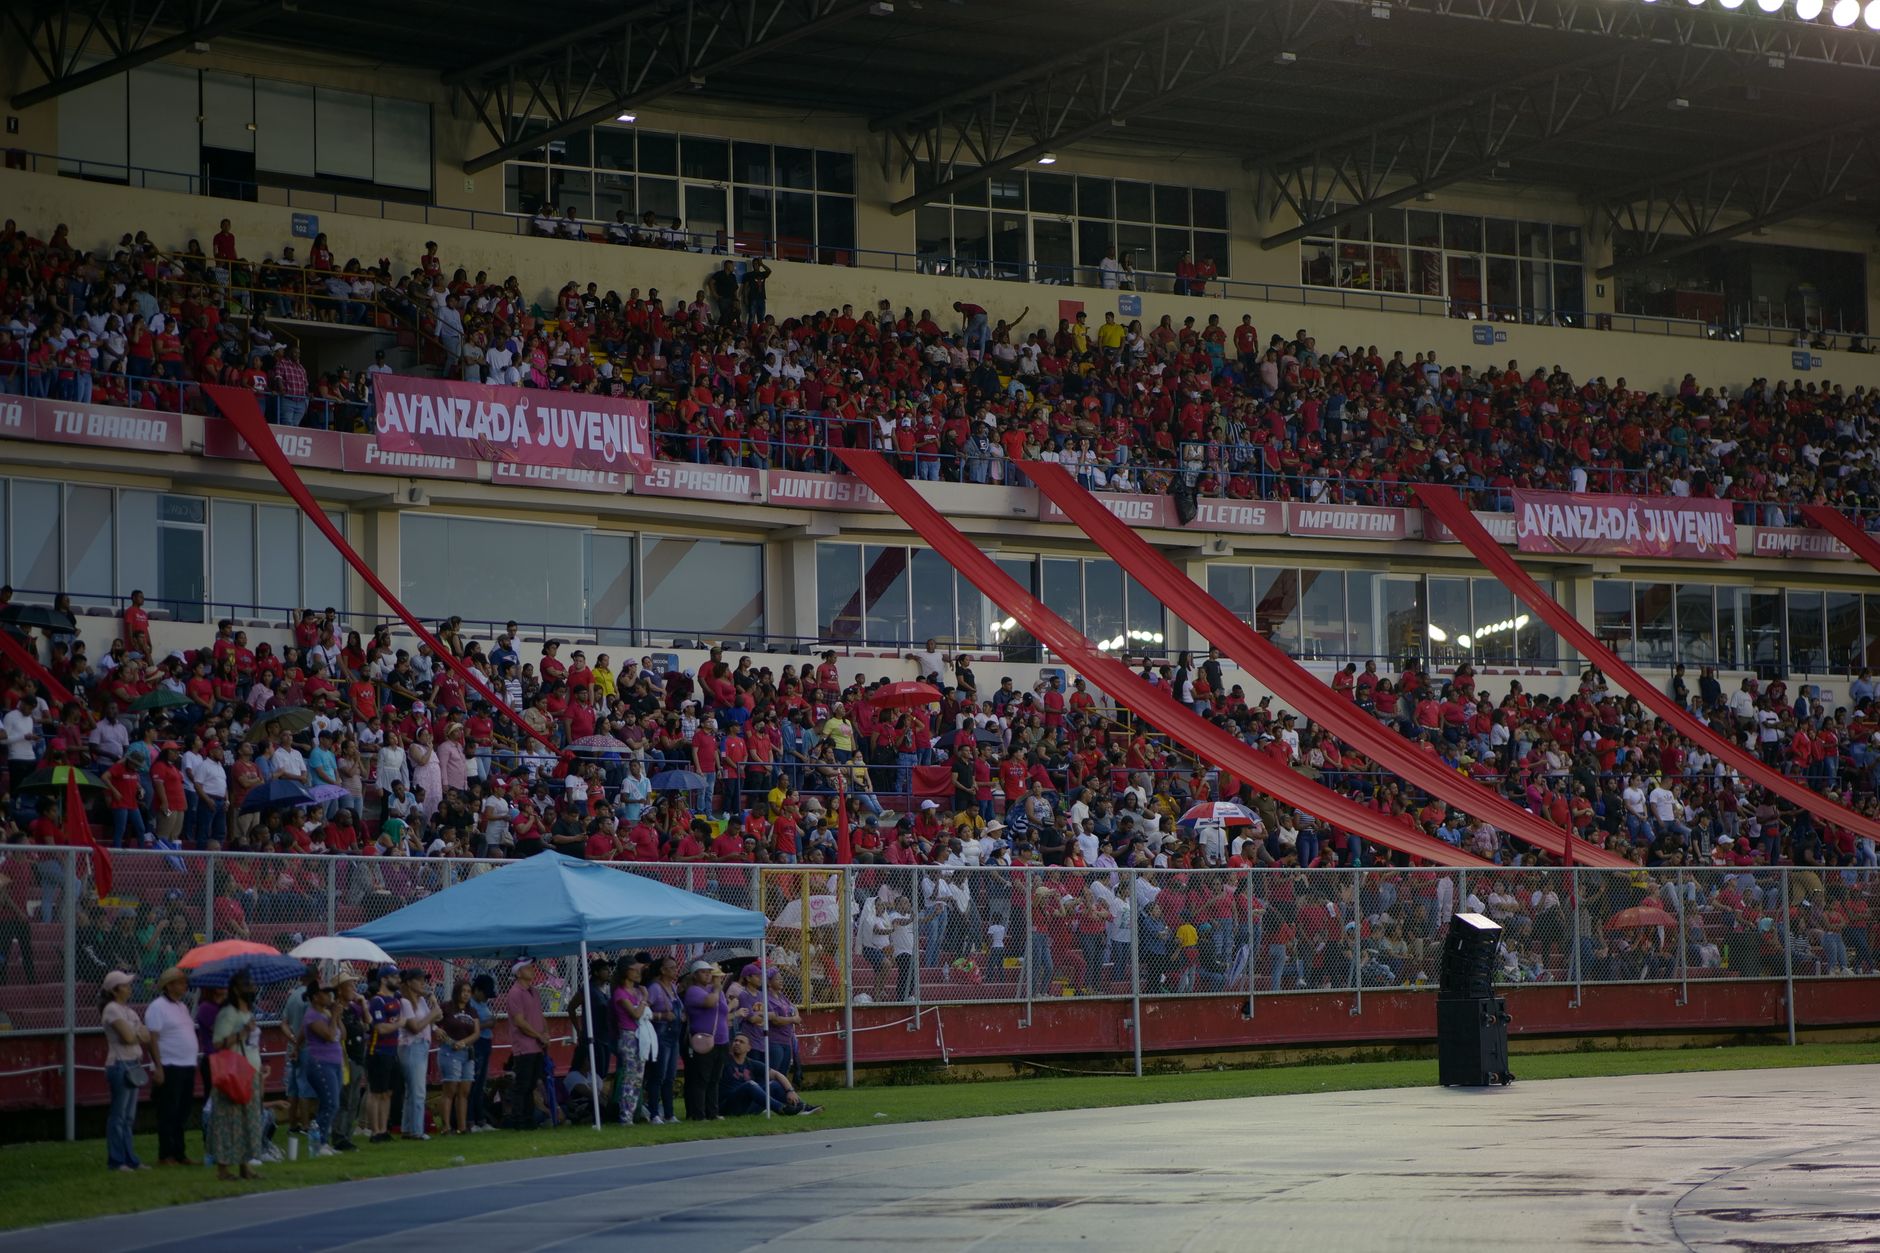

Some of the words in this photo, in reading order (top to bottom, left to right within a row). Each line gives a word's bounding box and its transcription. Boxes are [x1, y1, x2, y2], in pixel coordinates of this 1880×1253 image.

[53, 410, 83, 434] TU
[87, 414, 168, 442] BARRA
[377, 392, 532, 447] AVANZADA
[537, 407, 645, 457] JUVENIL
[497, 462, 520, 477] EL
[525, 464, 619, 485] DEPORTE
[645, 467, 671, 488] ES
[674, 469, 750, 494] PASIÓN
[771, 477, 851, 501] JUNTOS
[1196, 504, 1266, 526] TLETAS
[1299, 510, 1396, 532] IMPORTAN
[1517, 503, 1641, 542] AVANZADA
[1643, 509, 1731, 547] JUVENIL
[1757, 532, 1851, 554] CAMPEONES
